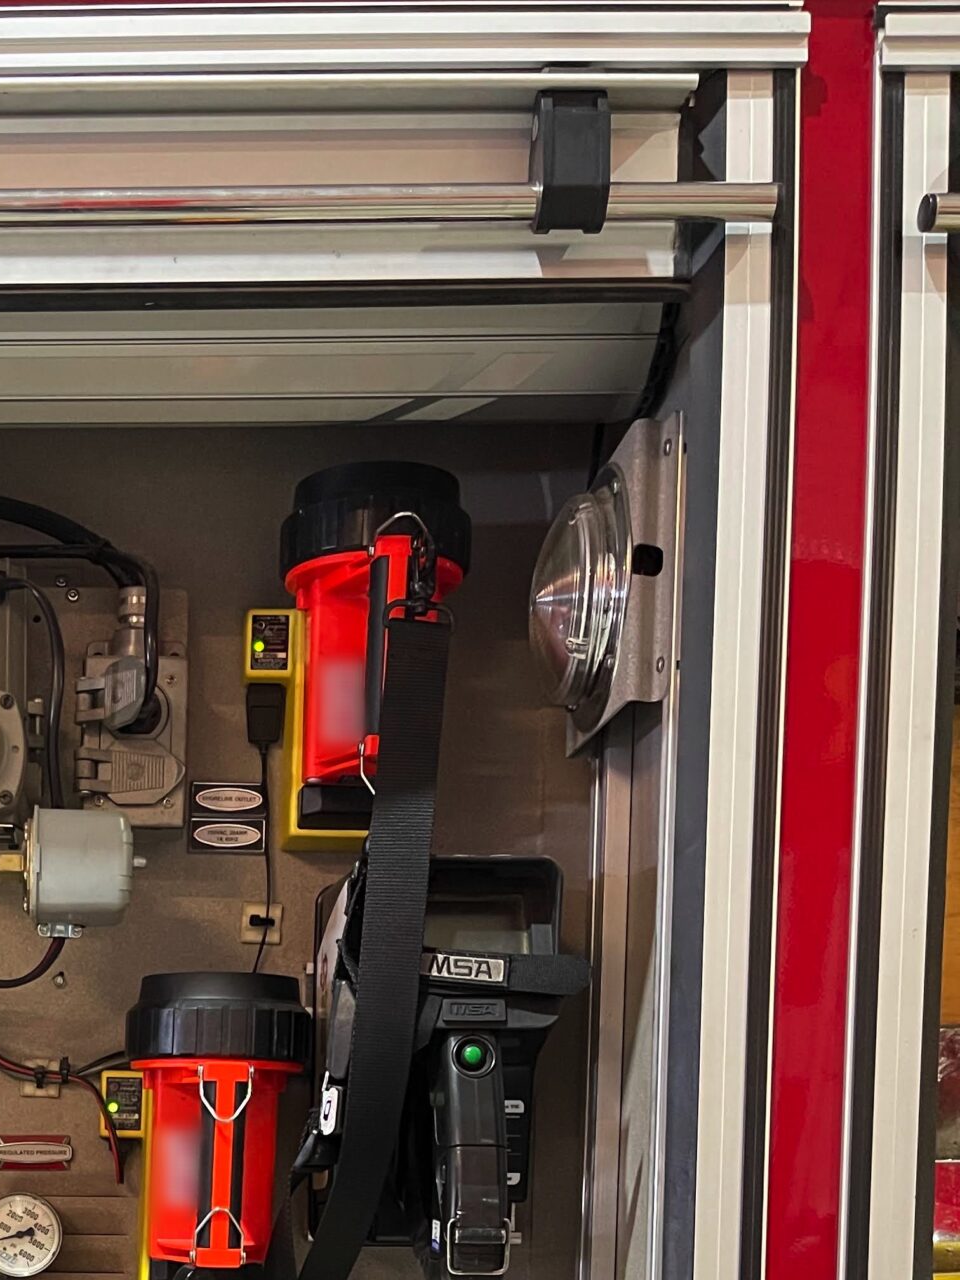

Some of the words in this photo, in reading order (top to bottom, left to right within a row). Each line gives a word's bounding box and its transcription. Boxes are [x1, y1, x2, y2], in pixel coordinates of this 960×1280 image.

[429, 954, 493, 979] MSA
[450, 1002, 499, 1016] MSA
[6, 1209, 24, 1222] 2000
[22, 1207, 39, 1221] 3000
[33, 1222, 50, 1236] 4000
[28, 1237, 45, 1251] 5000
[18, 1248, 36, 1262] 6000
